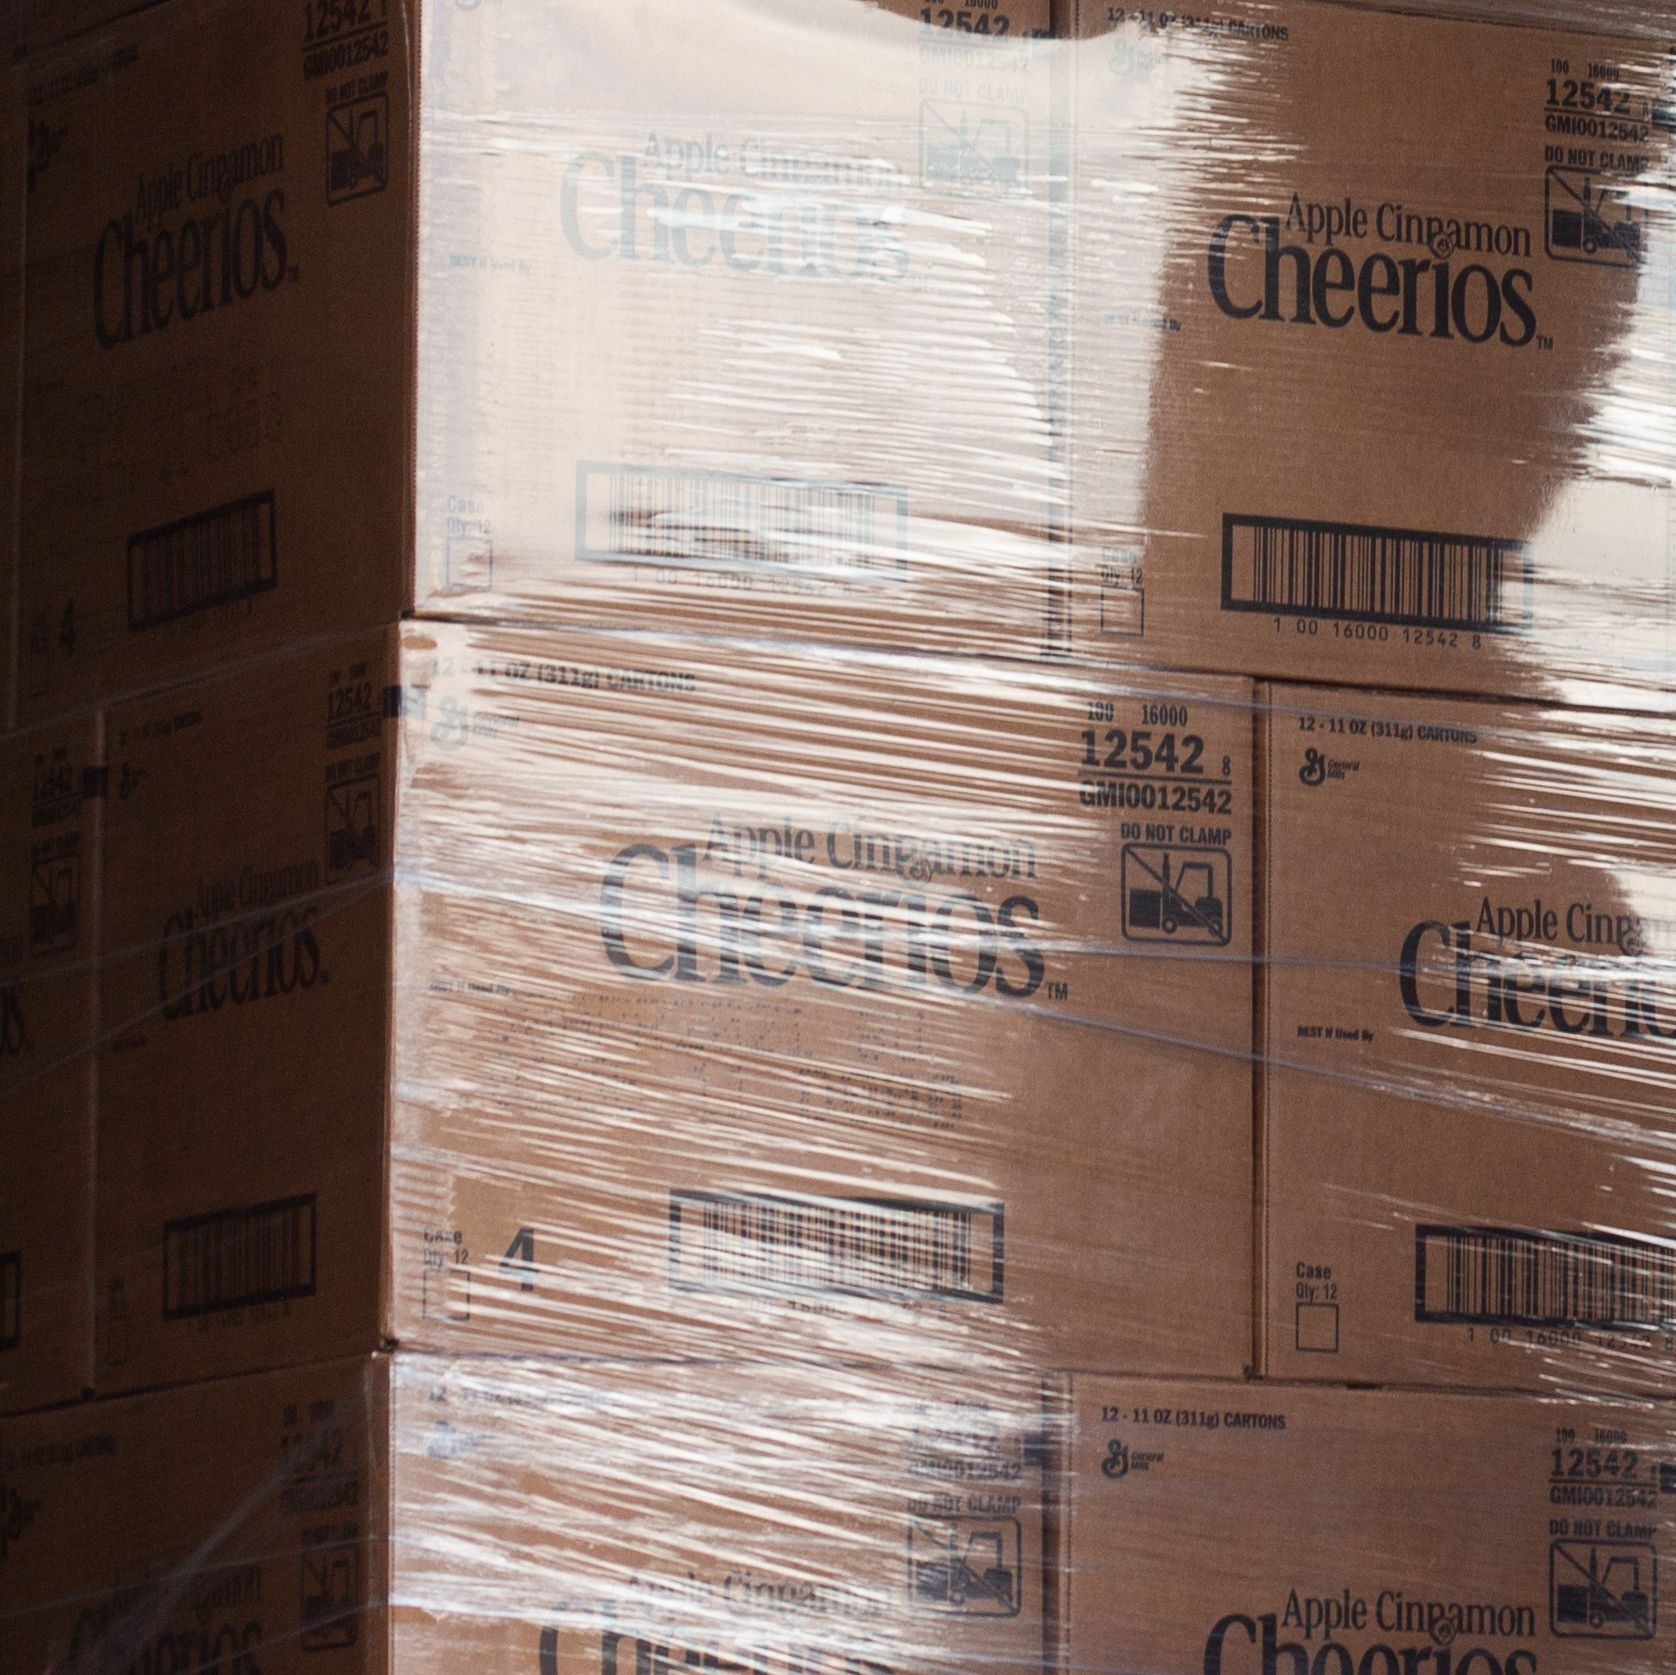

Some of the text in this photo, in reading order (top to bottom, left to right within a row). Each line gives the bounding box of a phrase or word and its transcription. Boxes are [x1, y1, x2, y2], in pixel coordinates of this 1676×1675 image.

[918, 9, 1010, 45] 12542
[1544, 79, 1631, 115] 12542
[134, 158, 184, 224] Apple
[559, 151, 911, 283] Cheerios
[1285, 192, 1532, 258] Apple Cinnamon
[92, 186, 288, 352] Cheerios
[1207, 214, 1537, 348] Cheerios
[1080, 729, 1205, 774] 12542
[1299, 716, 1317, 733] 12
[1331, 717, 1346, 734] 11
[1349, 719, 1367, 736] OZ
[1417, 724, 1478, 745] CARTONS
[1079, 783, 1232, 815] GMI0012542
[703, 812, 1039, 881] Apple Cinnamon
[1121, 823, 1232, 846] DO NOT CLAMP
[600, 844, 1046, 998] Cheerios
[1296, 1262, 1332, 1281] Case
[1101, 1407, 1286, 1431] 12 11 OZ (311g) CARTONS
[1550, 1447, 1639, 1479] 12542
[1281, 1589, 1536, 1644] Apple Cinnamon
